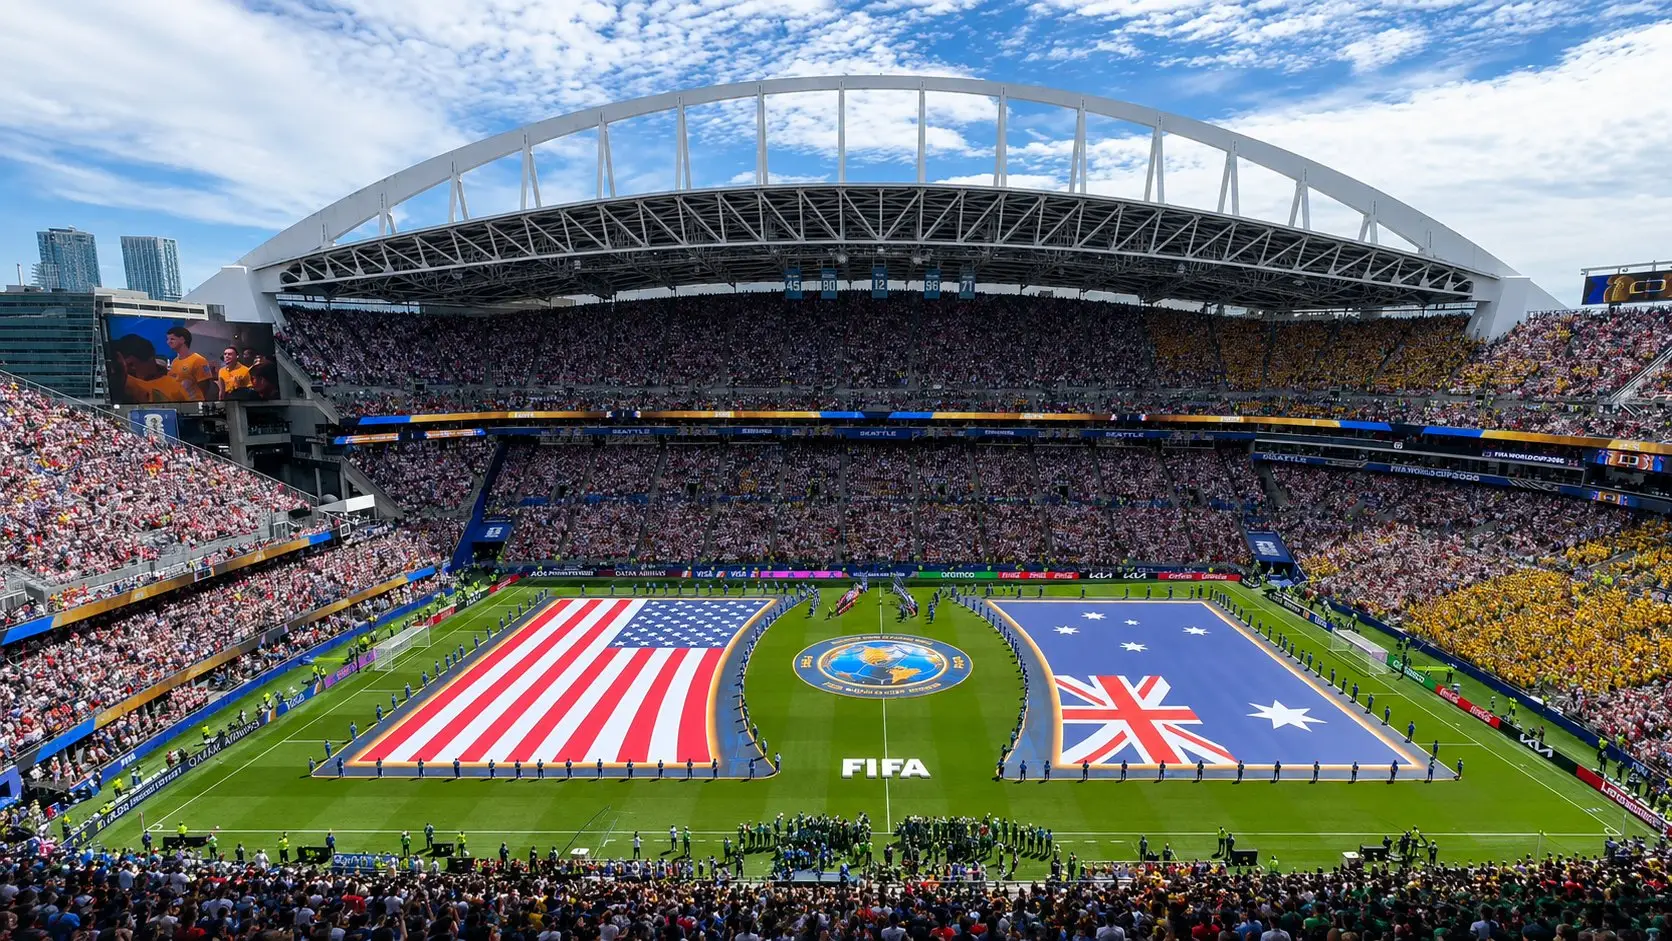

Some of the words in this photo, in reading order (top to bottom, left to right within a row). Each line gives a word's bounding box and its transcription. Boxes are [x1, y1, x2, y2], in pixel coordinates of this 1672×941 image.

[786, 280, 800, 291] 45
[874, 279, 885, 290] 12
[941, 570, 975, 579] aramco
[841, 758, 931, 779] FIFA
